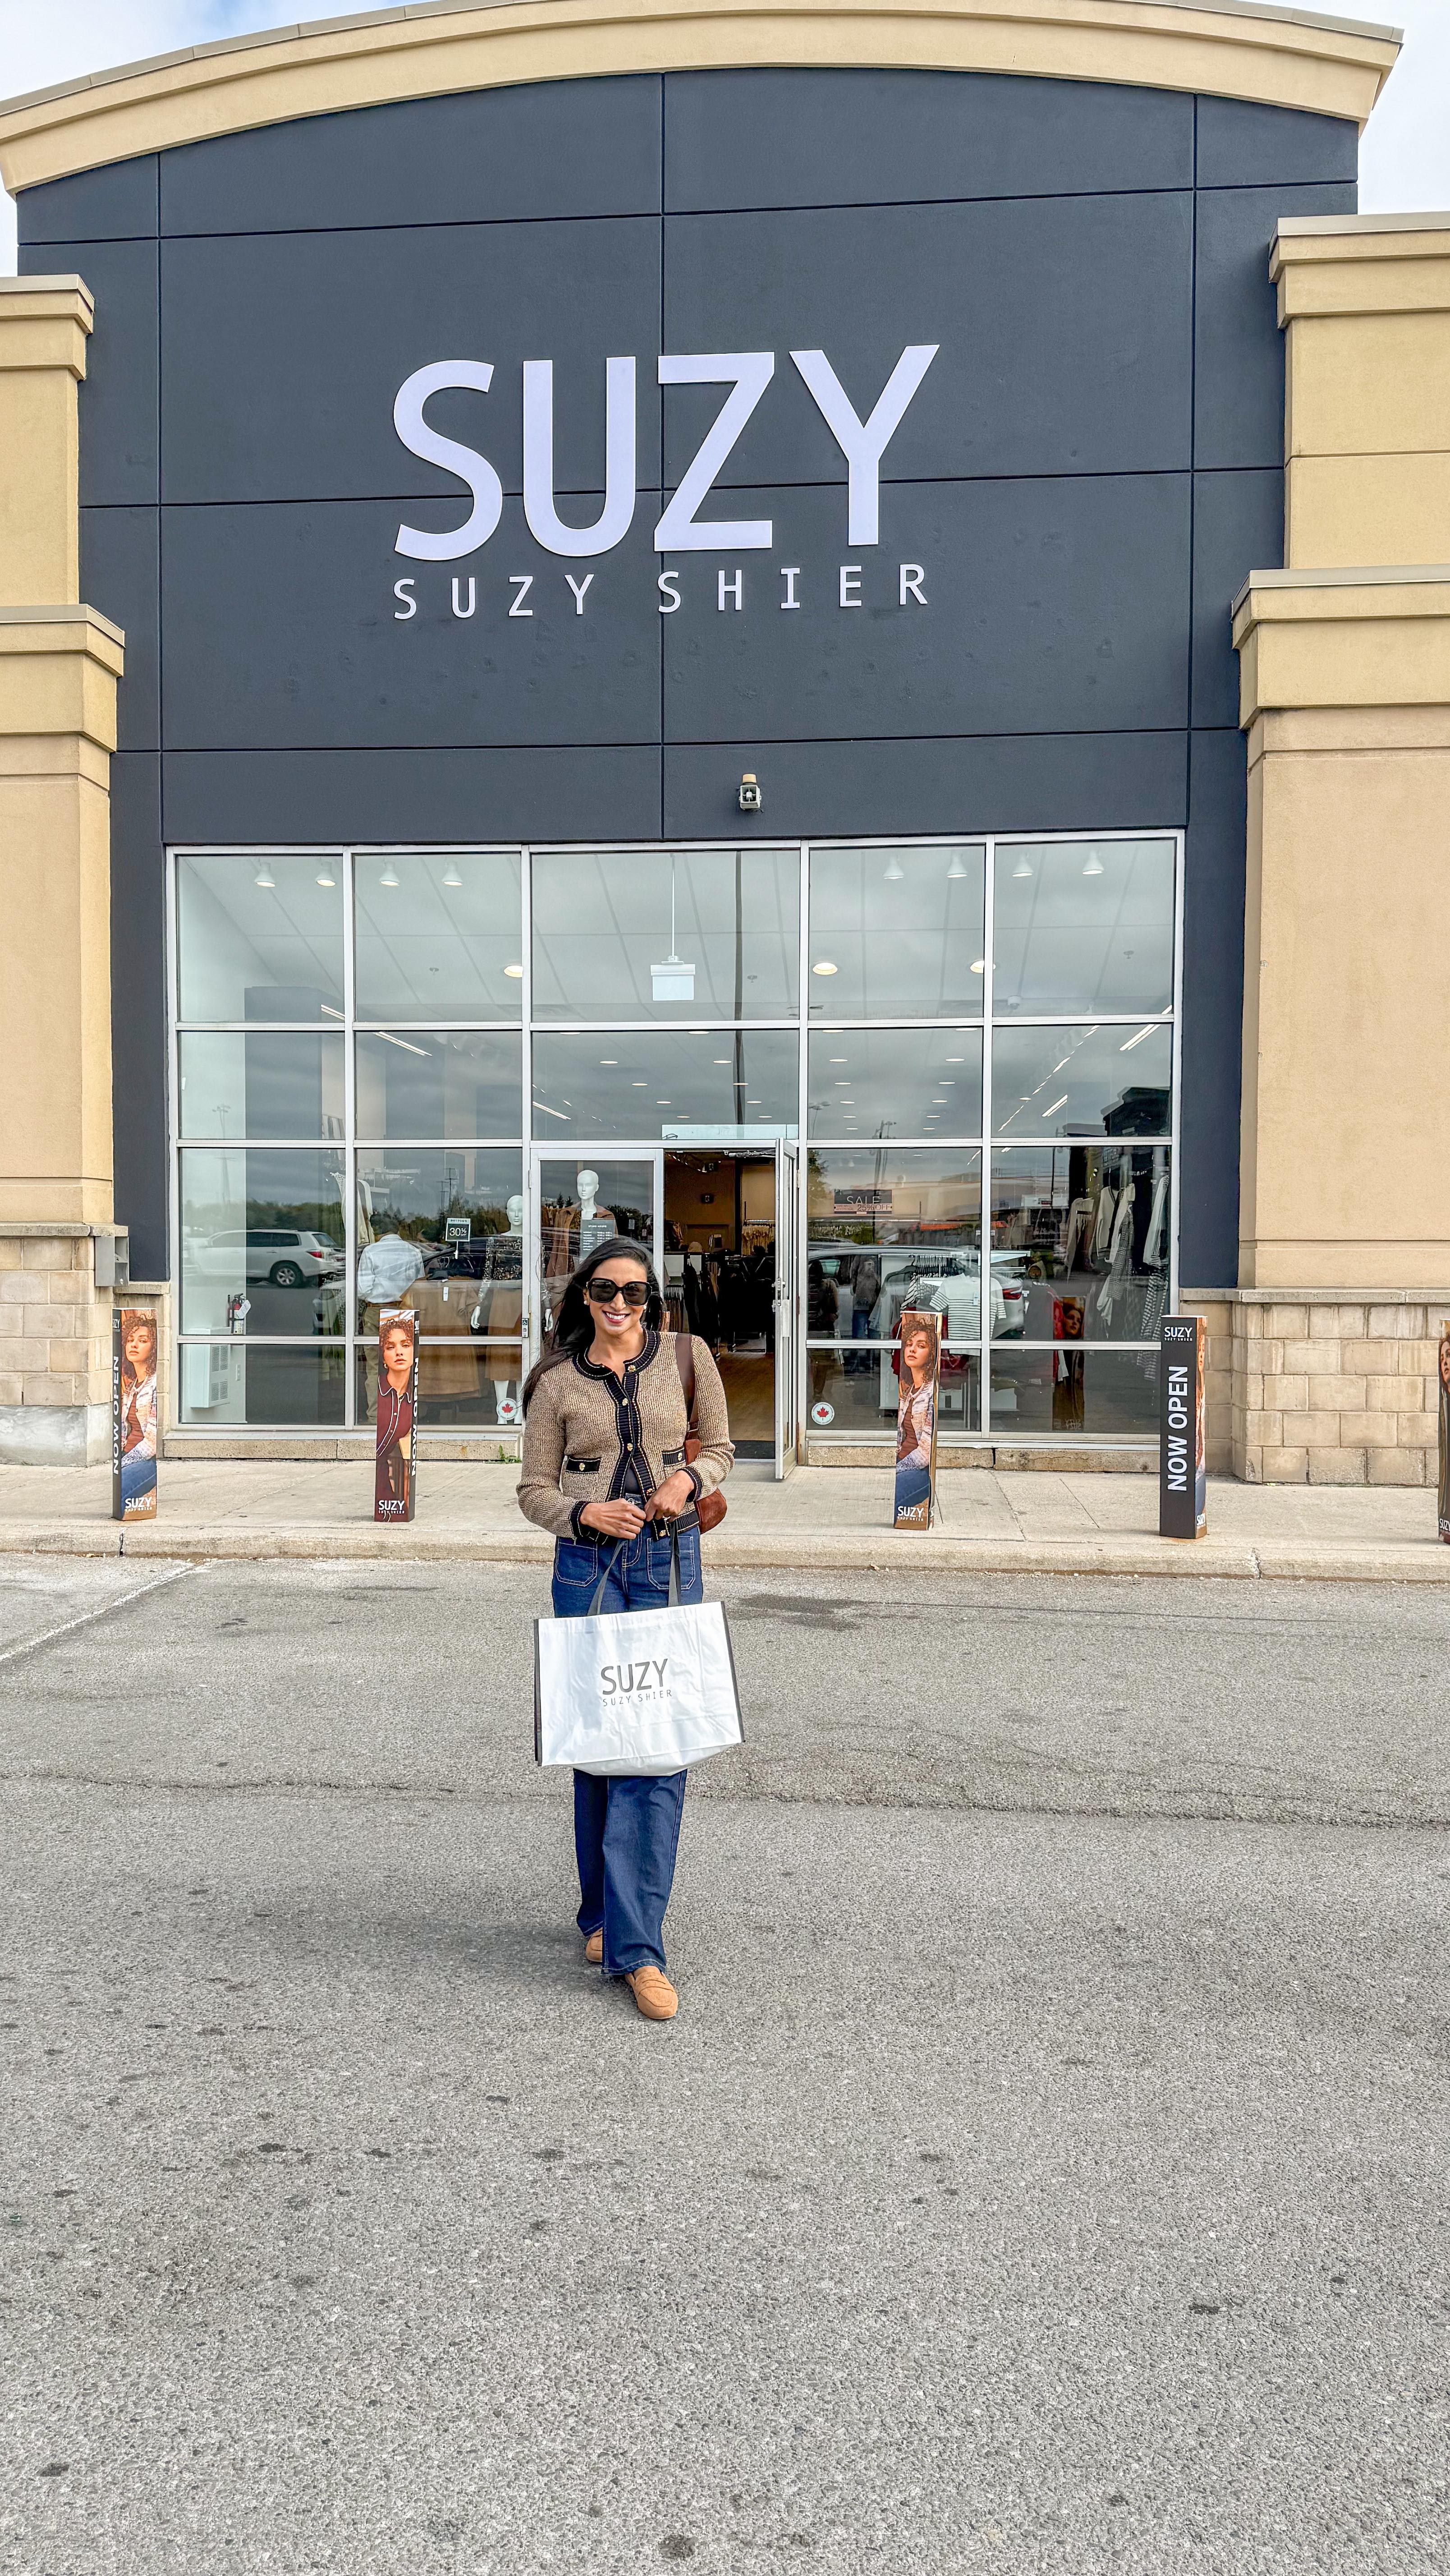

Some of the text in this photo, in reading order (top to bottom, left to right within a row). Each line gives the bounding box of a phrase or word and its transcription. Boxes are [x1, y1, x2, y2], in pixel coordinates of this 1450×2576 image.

[393, 344, 940, 561] SUZY
[393, 563, 928, 620] SUZY SHIER
[1164, 1327, 1193, 1338] SUZY
[1168, 1366, 1188, 1491] NOW OPEN
[125, 1496, 152, 1509] SUZY
[378, 1500, 405, 1510] SUZY
[898, 1506, 924, 1518] SUZY
[601, 1658, 668, 1695] SUZY
[603, 1689, 672, 1707] SUZY SHIER
